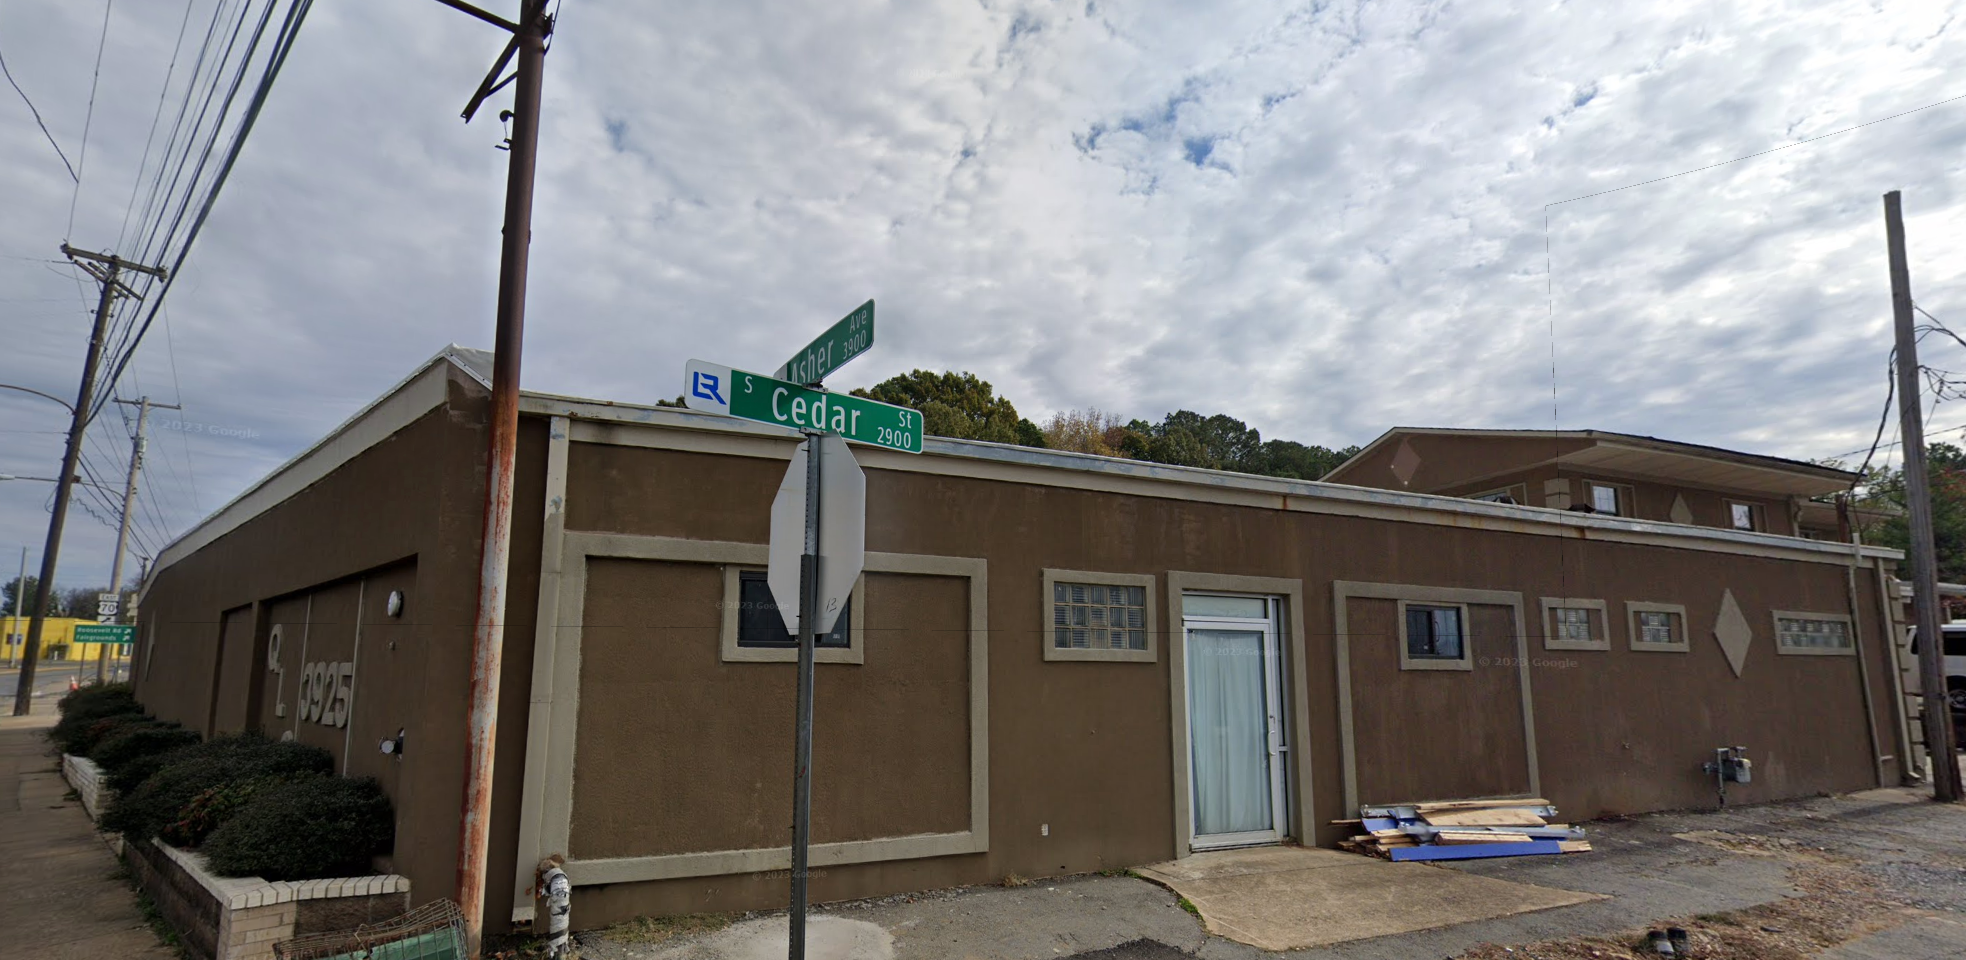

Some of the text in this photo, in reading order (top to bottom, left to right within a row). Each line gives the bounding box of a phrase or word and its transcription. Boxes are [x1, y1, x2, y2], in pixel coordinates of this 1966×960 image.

[849, 309, 867, 334] Ave
[842, 329, 867, 361] 3900
[790, 338, 834, 384] Asher
[744, 375, 753, 394] S
[771, 386, 861, 436] Cedar
[898, 410, 912, 429] St
[877, 426, 912, 449] 2900
[101, 603, 116, 613] 70
[75, 634, 117, 642] Fairgrounds
[300, 661, 353, 729] 3925
